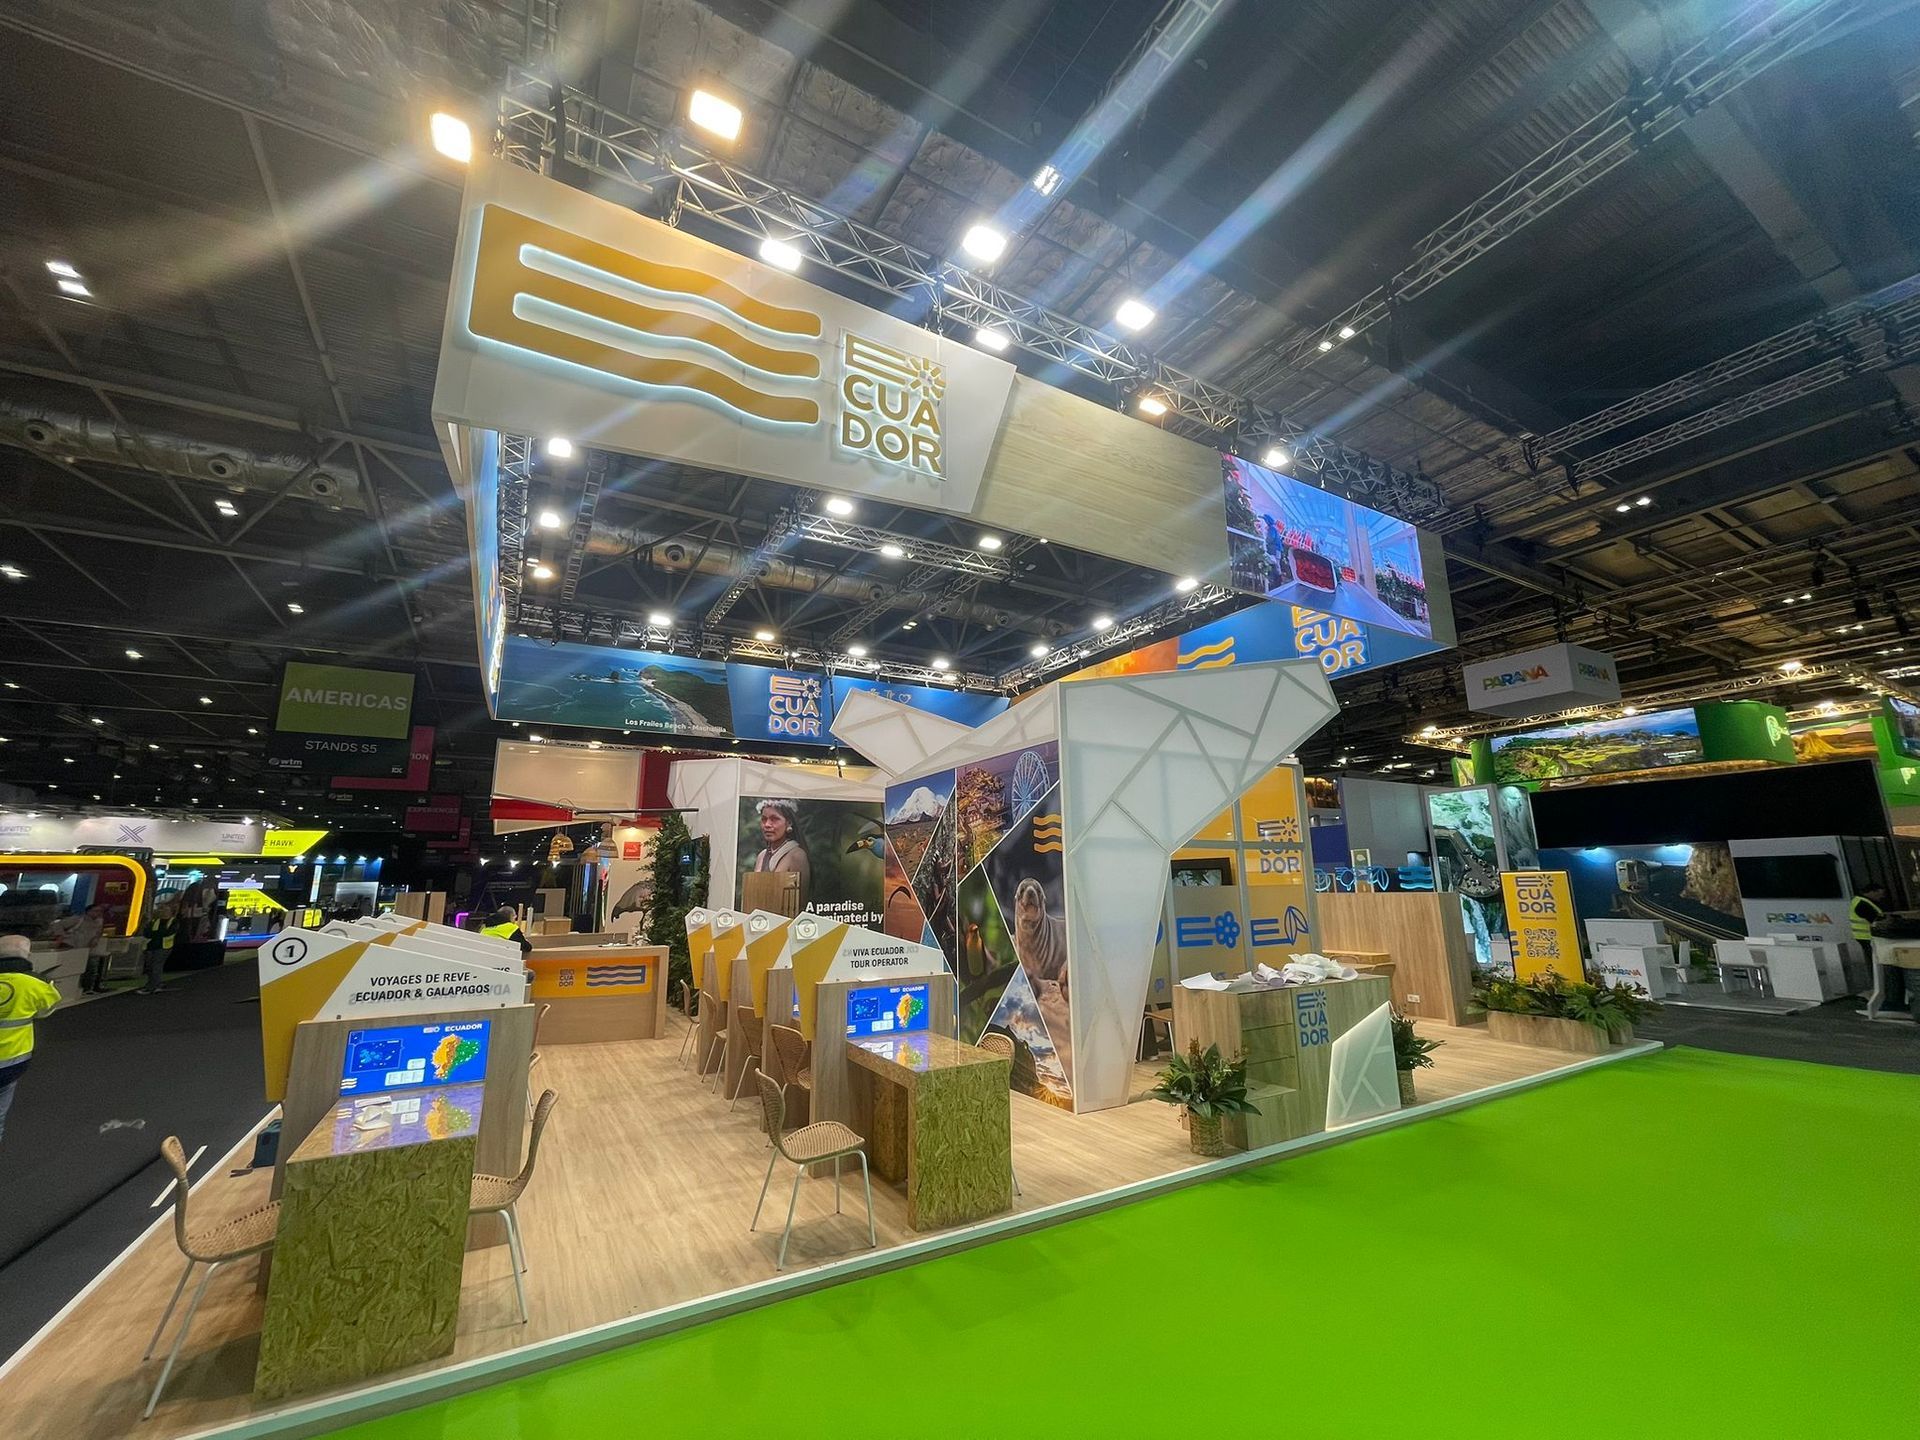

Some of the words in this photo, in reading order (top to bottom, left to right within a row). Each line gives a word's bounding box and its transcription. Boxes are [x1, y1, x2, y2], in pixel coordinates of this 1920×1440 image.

[1319, 639, 1366, 675] OR
[285, 687, 408, 711] AMERICAS
[625, 718, 638, 726] Los
[639, 719, 663, 728] Frailes
[304, 740, 359, 752] STANDS
[361, 743, 378, 754] S5
[270, 839, 294, 847] HAWK
[805, 901, 815, 912] A
[816, 900, 864, 914] paradise
[870, 912, 884, 924] by
[852, 948, 869, 957] VIVA
[871, 946, 905, 956] ECUADOR
[850, 959, 870, 968] TOUR
[872, 957, 909, 967] OPERATOR
[370, 974, 422, 987] VOYAGES
[425, 974, 440, 984] DE
[443, 972, 470, 982] REVE
[355, 989, 411, 1002] ECUADOR
[414, 987, 423, 998] &
[426, 984, 490, 997] GALAPAGOS
[445, 1023, 483, 1032] ECUADOR
